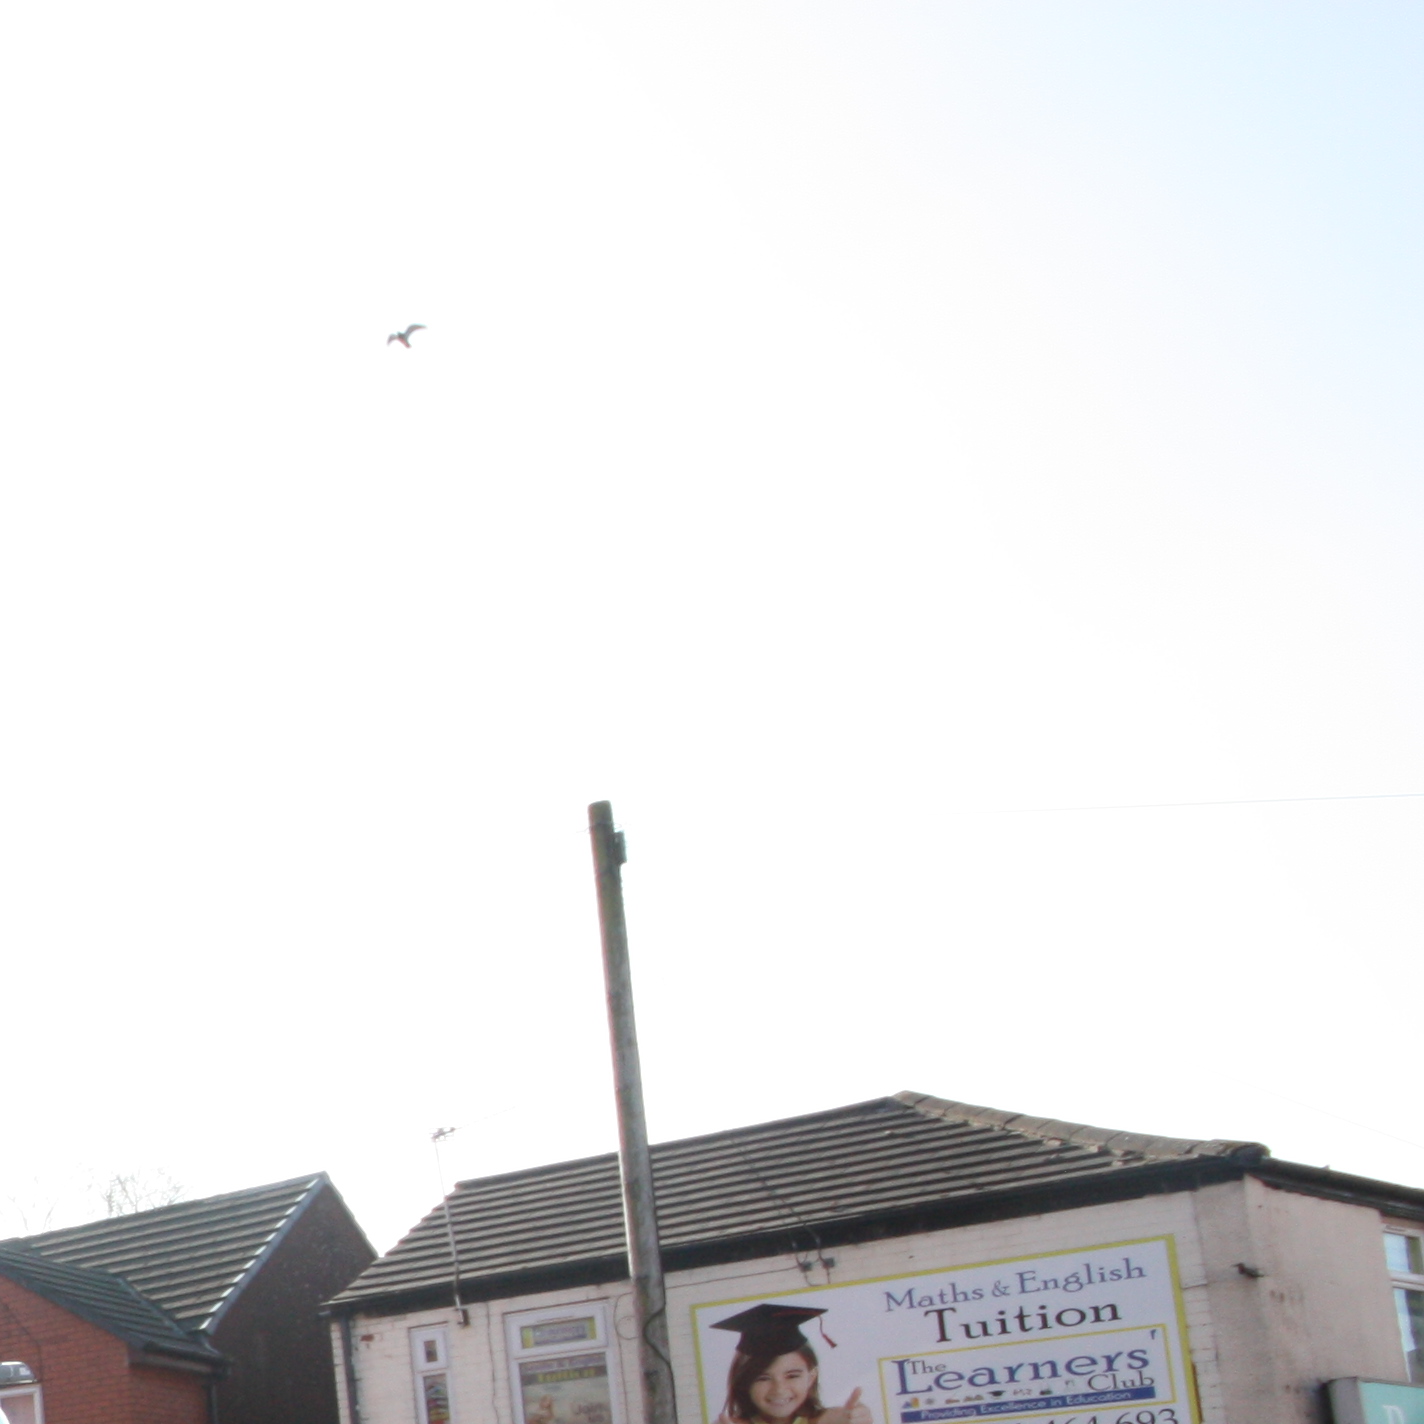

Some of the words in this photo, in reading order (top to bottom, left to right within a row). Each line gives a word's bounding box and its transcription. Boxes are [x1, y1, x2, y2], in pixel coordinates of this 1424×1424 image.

[884, 1283, 984, 1312] Maths
[992, 1280, 1010, 1297] &
[1015, 1258, 1147, 1293] English
[923, 1303, 1122, 1343] Tuition
[907, 1360, 947, 1375] The
[1087, 1370, 1155, 1392] Club
[920, 1405, 977, 1420] Providing
[980, 1399, 1046, 1413] Excellence
[1050, 1396, 1062, 1407] in
[1066, 1390, 1131, 1406] Education
